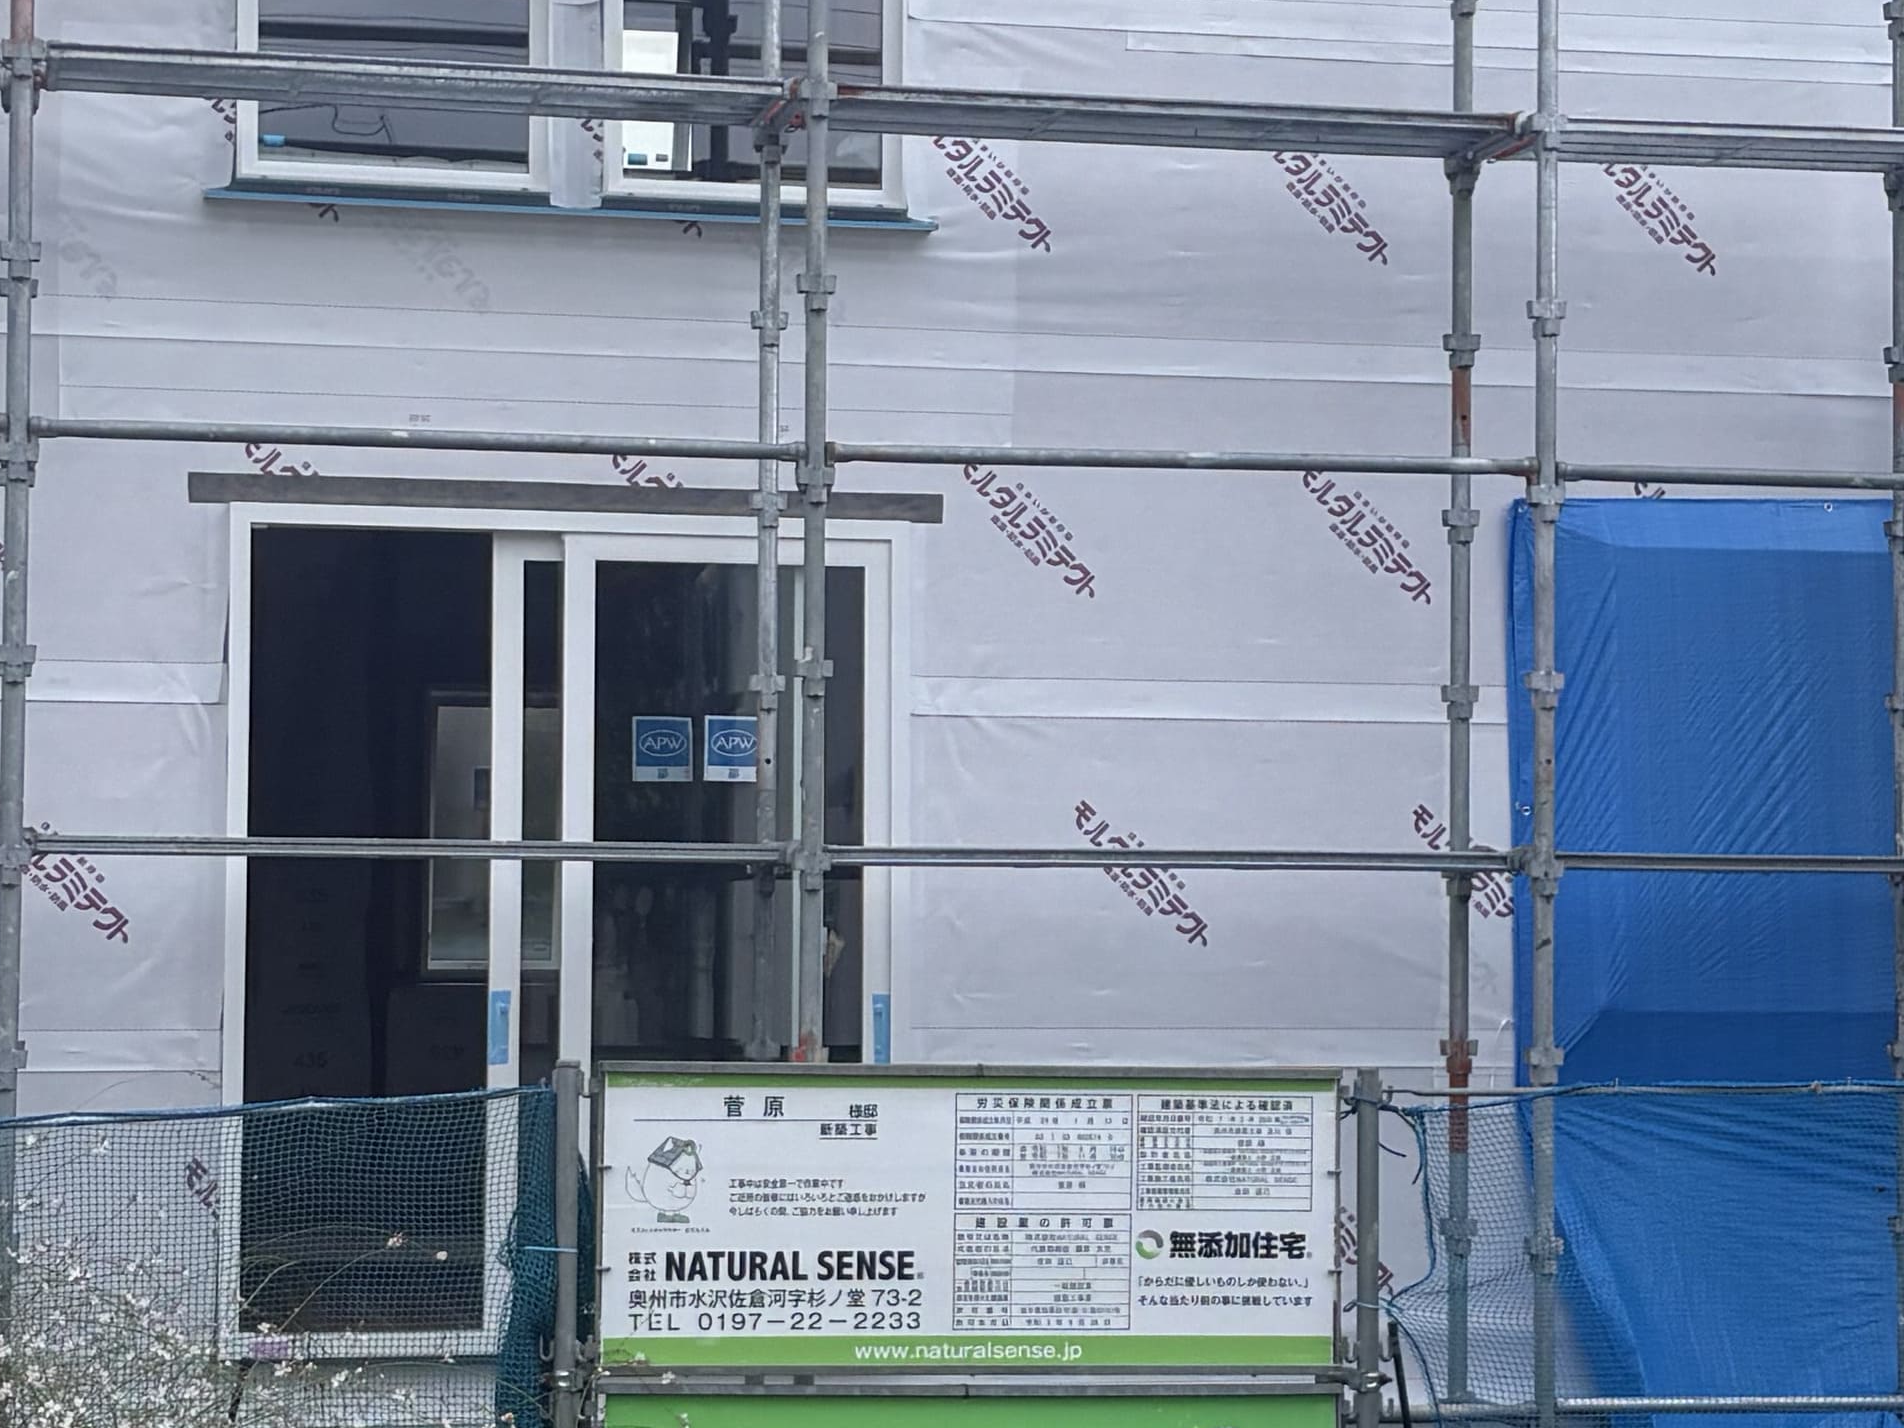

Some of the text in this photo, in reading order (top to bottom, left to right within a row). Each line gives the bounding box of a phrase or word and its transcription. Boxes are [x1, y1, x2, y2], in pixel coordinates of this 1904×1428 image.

[1169, 1231, 1307, 1260] 無添加住宅
[665, 1250, 915, 1281] NATURAL SENSE
[871, 1289, 923, 1307] 73-2
[629, 1314, 681, 1331] TEL
[854, 1342, 1082, 1361] www.naturalsense.jp
